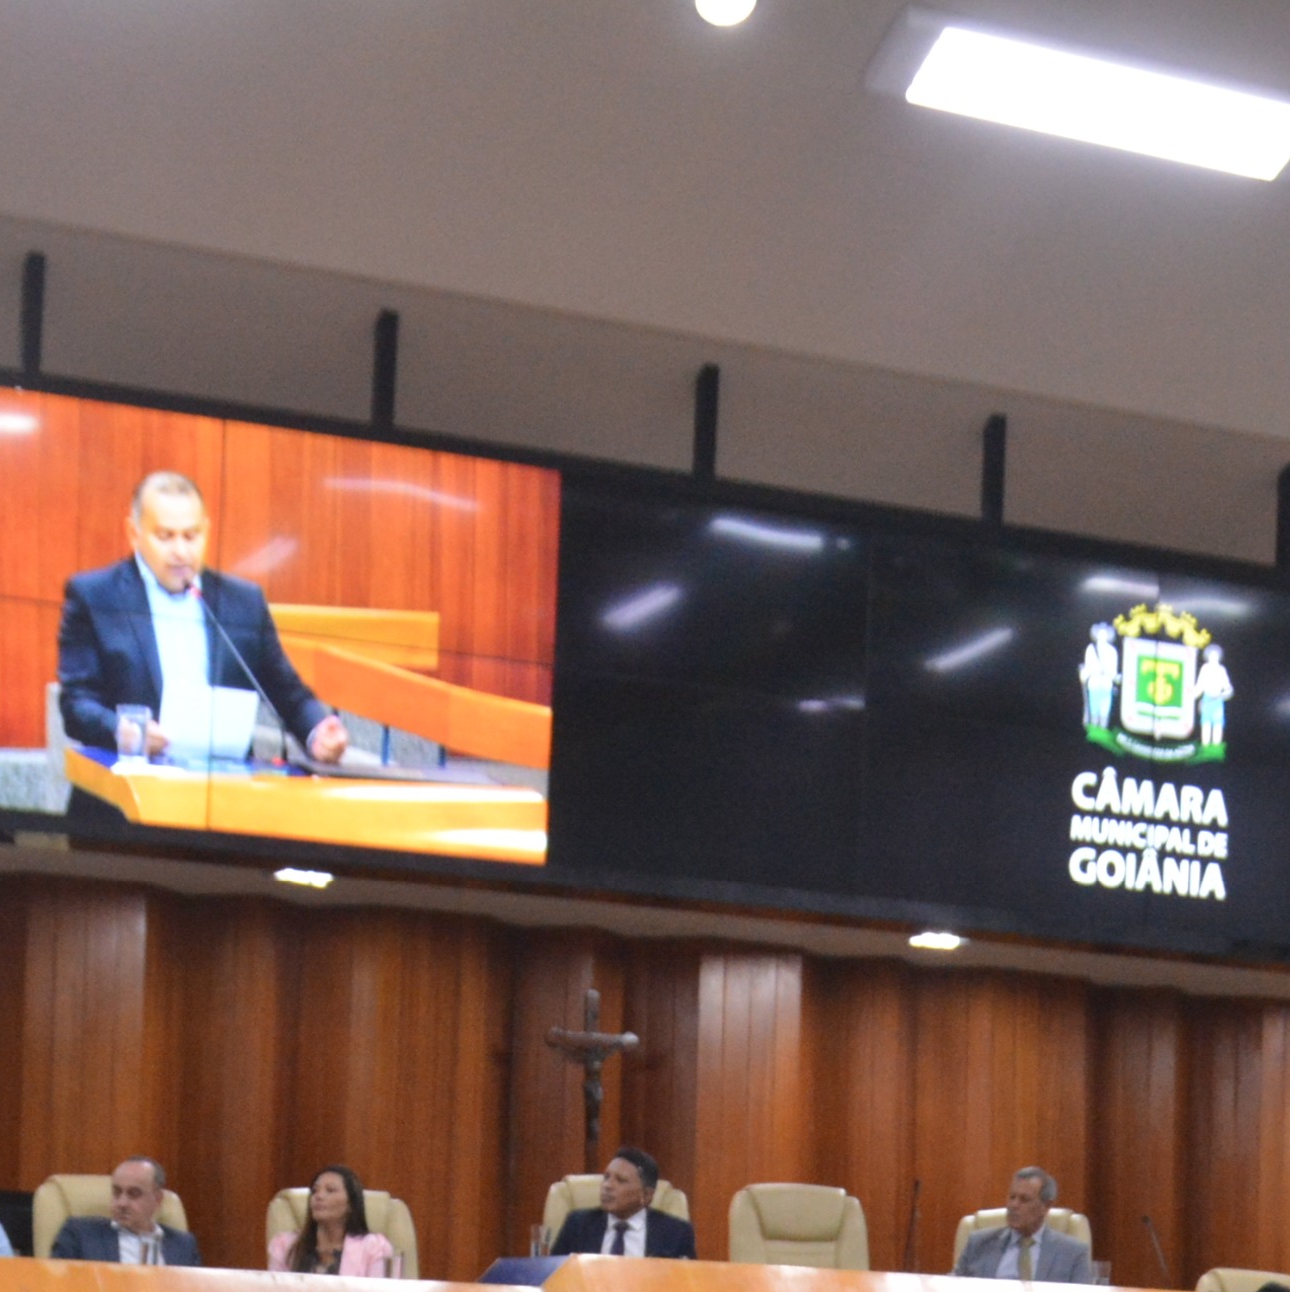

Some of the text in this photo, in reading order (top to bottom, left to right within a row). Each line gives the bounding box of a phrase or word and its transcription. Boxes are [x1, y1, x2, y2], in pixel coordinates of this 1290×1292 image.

[1071, 766, 1228, 828] CÂMARA
[1070, 814, 1228, 860] MUNICIPAL DE
[1069, 846, 1227, 900] GOIÂNIA
